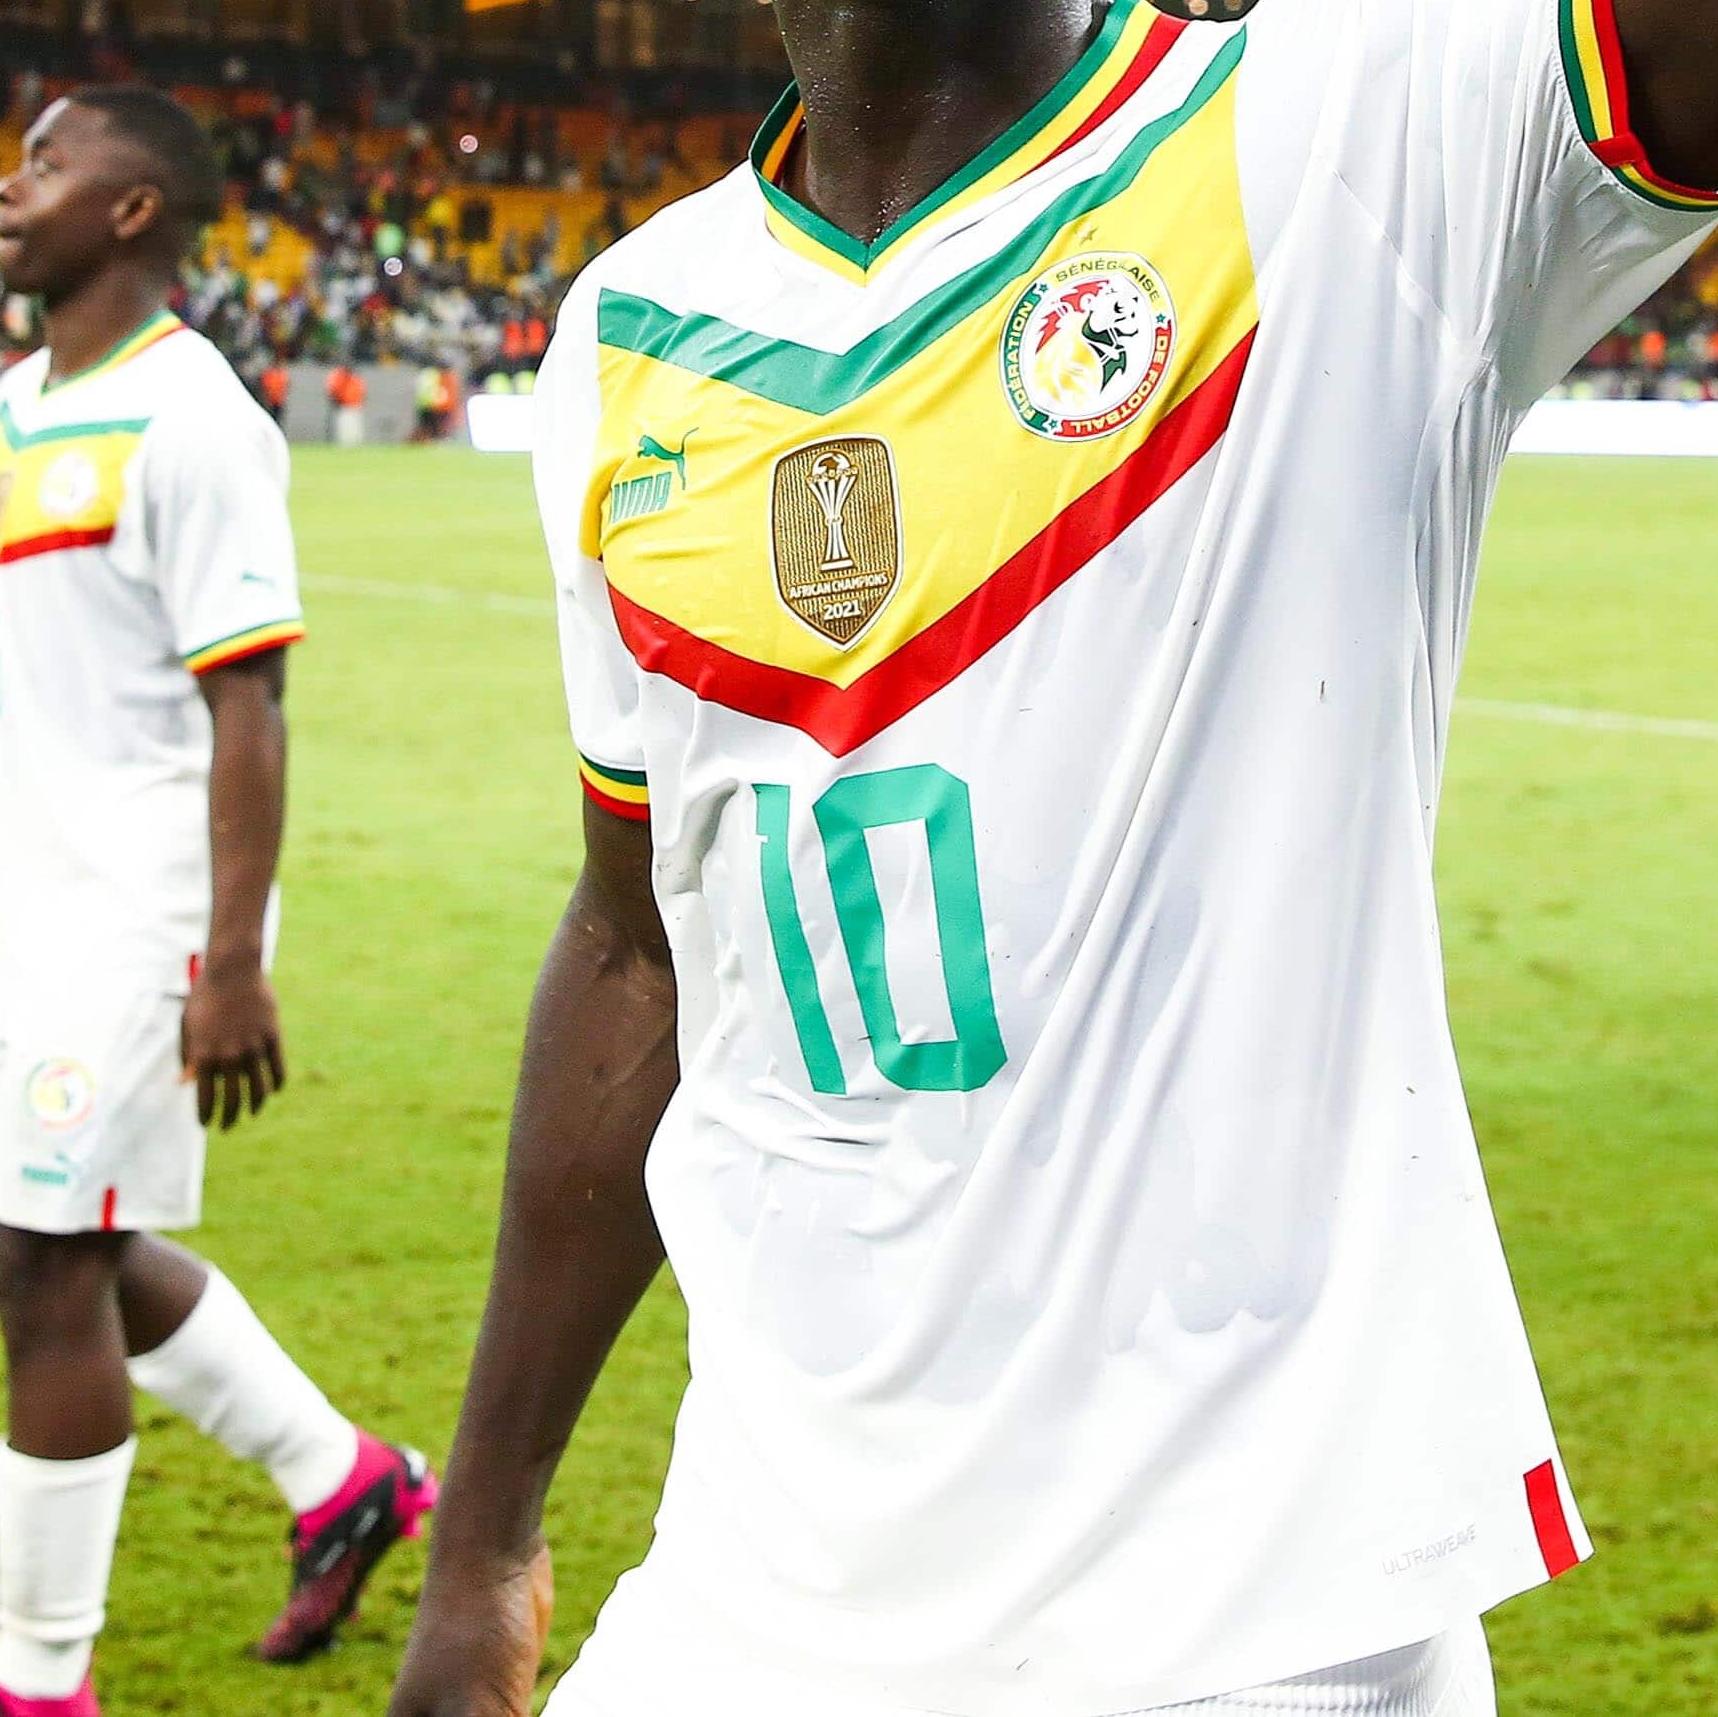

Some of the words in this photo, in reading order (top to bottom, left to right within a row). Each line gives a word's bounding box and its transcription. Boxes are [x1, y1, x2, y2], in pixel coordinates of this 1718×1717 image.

[1153, 335, 1168, 364] DE
[1070, 368, 1159, 434] FOOTBALL
[789, 582, 831, 598] AFRICAN
[832, 571, 888, 592] CHAMPIONS
[823, 599, 862, 621] 2021
[751, 763, 1009, 1095] 10
